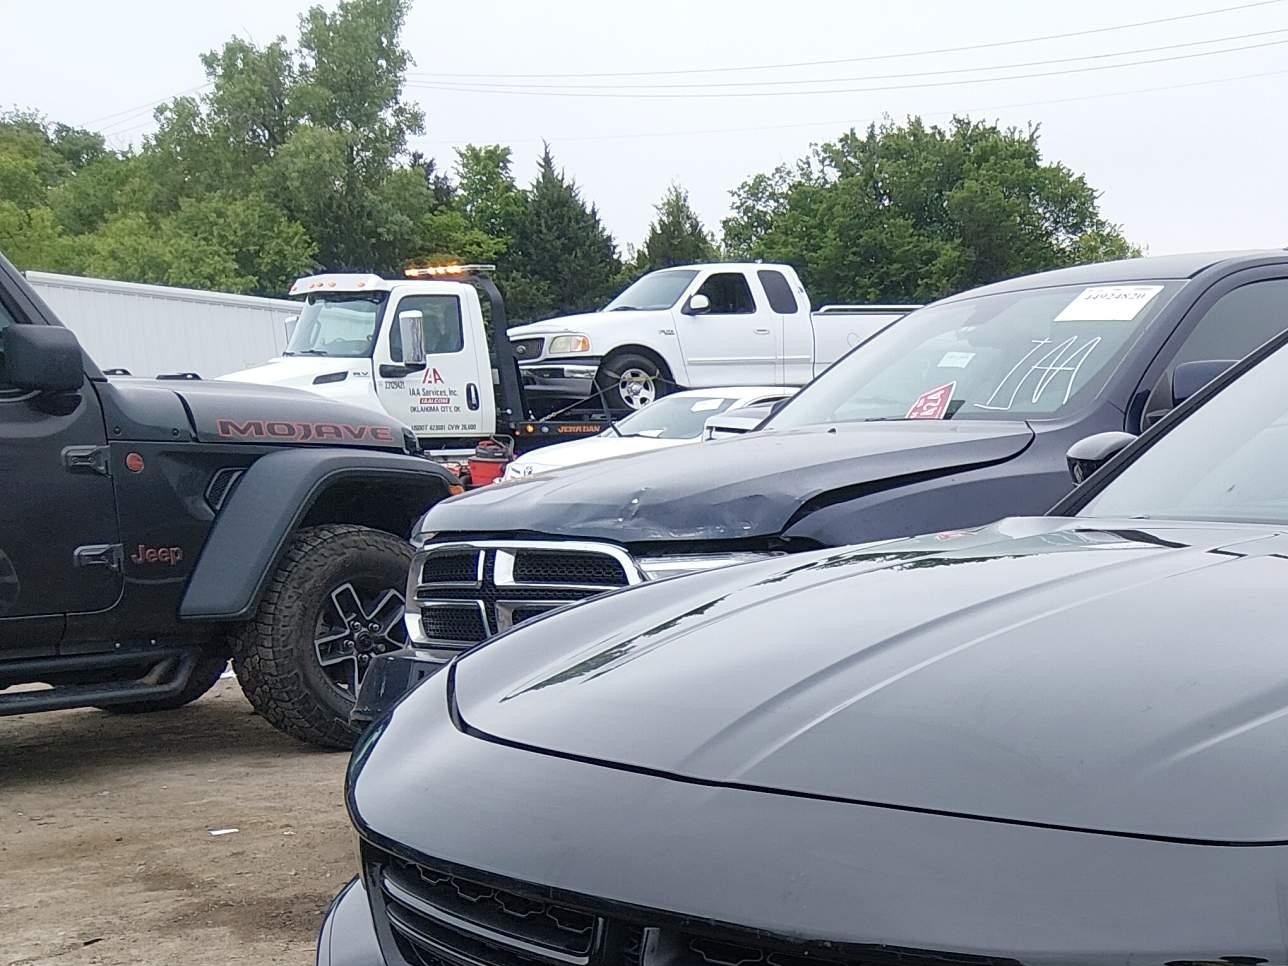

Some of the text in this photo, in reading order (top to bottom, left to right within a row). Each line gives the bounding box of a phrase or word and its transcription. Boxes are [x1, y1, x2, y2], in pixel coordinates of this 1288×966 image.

[409, 387, 420, 397] IAA
[410, 405, 440, 413] OKLAHOMA
[216, 419, 394, 442] MOJAVE
[131, 544, 183, 566] Jeep
